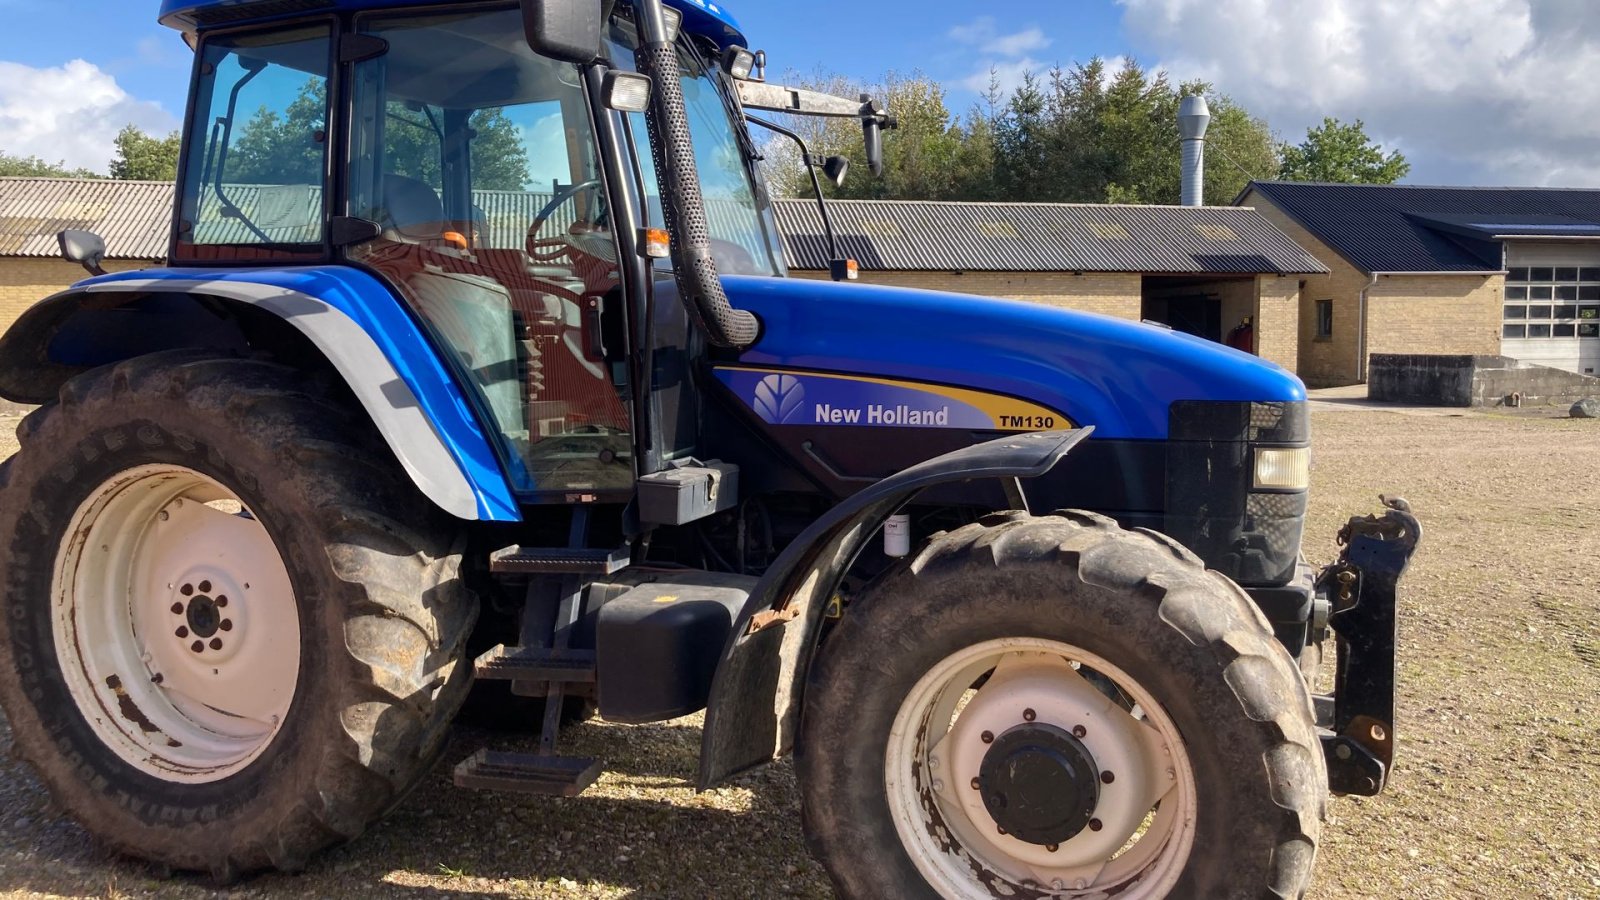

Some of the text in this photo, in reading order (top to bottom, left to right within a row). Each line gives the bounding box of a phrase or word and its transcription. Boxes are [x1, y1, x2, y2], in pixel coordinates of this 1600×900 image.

[815, 403, 949, 426] New Holland
[998, 415, 1055, 429] TM130
